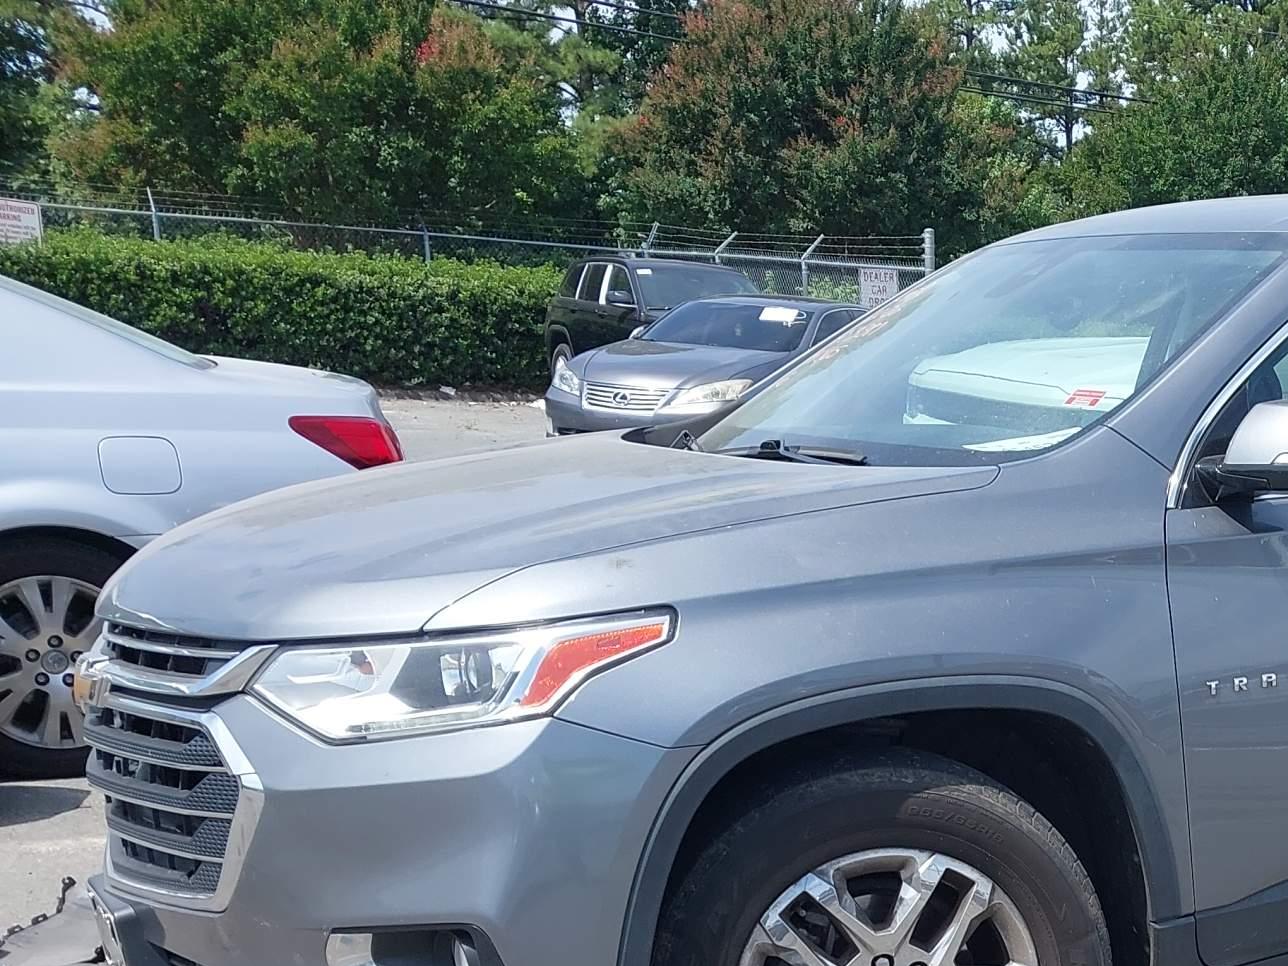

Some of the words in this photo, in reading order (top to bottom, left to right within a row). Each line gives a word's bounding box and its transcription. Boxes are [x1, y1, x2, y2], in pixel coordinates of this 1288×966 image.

[863, 271, 895, 282] DEALER
[871, 284, 887, 296] CAR
[868, 297, 889, 309] DRO
